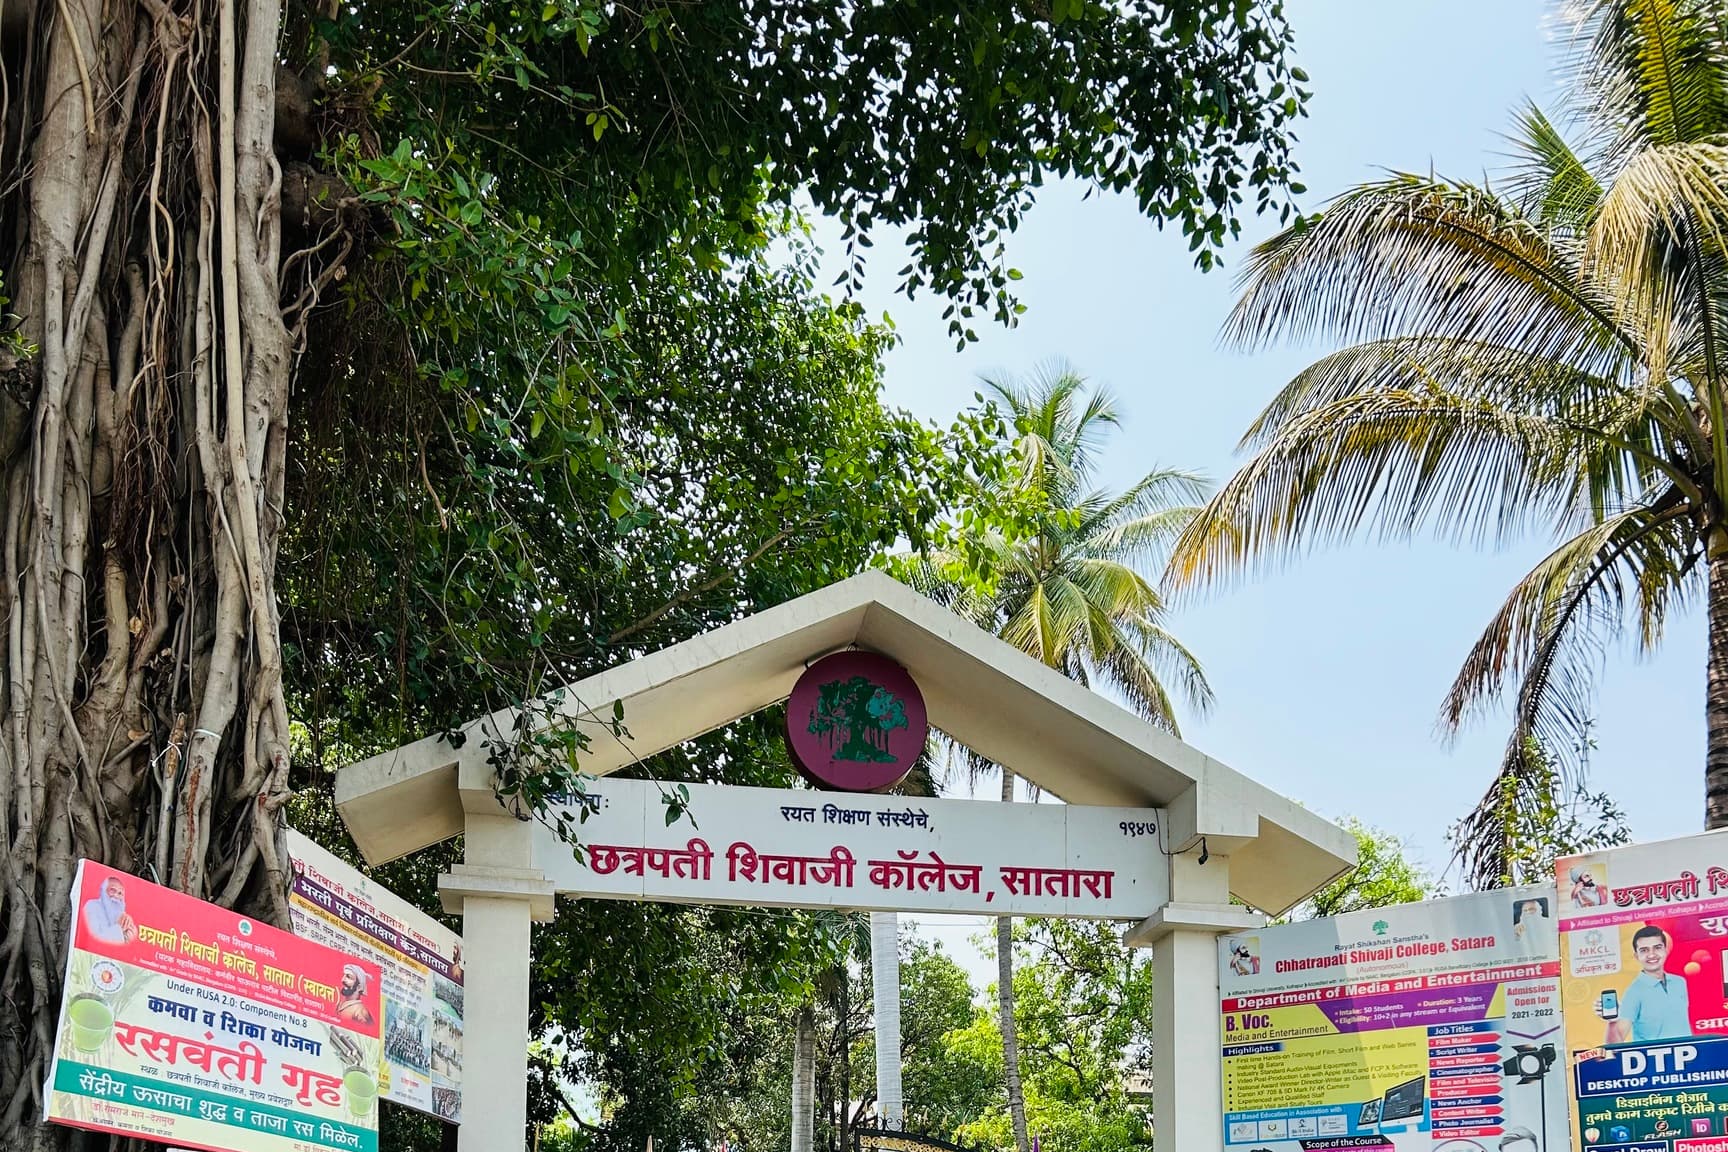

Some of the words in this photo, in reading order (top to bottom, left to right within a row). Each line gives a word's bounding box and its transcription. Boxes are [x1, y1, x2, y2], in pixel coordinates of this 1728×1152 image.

[780, 805, 817, 824] रयत
[822, 803, 871, 827] शिक्षण
[876, 807, 935, 833] संस्थेचे,
[1119, 821, 1157, 836] १९४७
[587, 838, 714, 881] छत्रपती
[726, 841, 858, 888] शिवाजी
[999, 866, 1115, 900] सातारा
[1611, 870, 1701, 907] छत्रपती
[301, 881, 332, 908] भरती
[356, 914, 397, 945] प्रशिक्षण
[1611, 913, 1633, 924] Shivaji
[1634, 909, 1667, 921] University,
[1668, 905, 1697, 916] Kolhapur
[1334, 943, 1355, 952] Rayat
[1392, 933, 1429, 944] Sanstha's
[138, 925, 178, 952] छत्रपती
[180, 931, 220, 965] शिवाजी
[263, 965, 295, 989] सातारा
[1275, 952, 1348, 973] Chhatrapati
[1350, 946, 1394, 964] Shivaji
[1396, 941, 1449, 958] College,
[1451, 935, 1495, 952] Satara
[1579, 946, 1610, 956] MKCL
[1357, 962, 1408, 974] (Autonomous)
[1237, 992, 1322, 1009] Department
[1326, 988, 1340, 999] of
[1345, 981, 1390, 996] Media
[1394, 977, 1422, 991] and
[1427, 965, 1542, 987] Entertainment
[1507, 984, 1557, 996] Admissions
[167, 979, 195, 995] Under
[196, 987, 221, 1003] RUSA
[240, 1000, 287, 1022] Component
[1423, 998, 1456, 1007] Duration:
[1464, 995, 1483, 1003] Years
[1514, 996, 1537, 1008] Open
[1537, 995, 1550, 1005] for
[1339, 1008, 1363, 1017] Intake:
[1373, 1003, 1404, 1012] Students
[1339, 1015, 1371, 1025] Eligibility:
[1373, 1013, 1390, 1021] 10+2
[1391, 1011, 1399, 1019] in
[1399, 1011, 1413, 1019] any
[1413, 1008, 1438, 1016] stream
[1448, 1004, 1486, 1013] Equivalent
[147, 995, 199, 1024] कमवा
[203, 1010, 217, 1028] व
[220, 1011, 268, 1041] शिका
[271, 1027, 323, 1057] योजना
[1225, 1015, 1239, 1032] B.
[1242, 1014, 1274, 1029] Voc.
[1225, 1033, 1250, 1043] Media
[1251, 1029, 1267, 1040] and
[1269, 1024, 1328, 1038] Entertainment
[1434, 1026, 1451, 1036] Job
[1451, 1025, 1474, 1034] Titles
[1436, 1038, 1451, 1046] Film
[1451, 1037, 1472, 1045] Maker
[1228, 1045, 1274, 1055] Highlights
[1436, 1048, 1456, 1057] Script
[1457, 1046, 1478, 1054] Writer
[1579, 1050, 1598, 1061] NEW
[114, 1020, 268, 1086] रसवंती
[280, 1062, 344, 1107] गृह
[1436, 1059, 1455, 1067] News
[1456, 1056, 1486, 1066] Reporter
[1621, 1045, 1698, 1076] DTP
[1436, 1066, 1495, 1077] Cinematographer
[166, 1069, 192, 1083] छत्रपती
[194, 1074, 220, 1090] शिवाजी
[1437, 1079, 1452, 1087] Film
[1452, 1077, 1466, 1085] and
[1587, 1077, 1649, 1091] DESKTOP
[1437, 1089, 1468, 1097] Producer
[1615, 1093, 1673, 1108] डिझाइनिंग
[1675, 1091, 1708, 1104] क्षेत्रात
[79, 1068, 126, 1098] सेंद्रीय
[132, 1085, 193, 1111] ऊसाचा
[199, 1099, 228, 1122] शुद्ध
[233, 1106, 247, 1123] व
[250, 1111, 288, 1133] ताजा
[293, 1120, 314, 1137] रस
[320, 1124, 364, 1149] मिळेल.
[1437, 1099, 1456, 1107] News
[1457, 1098, 1482, 1106] Anchor
[1260, 1110, 1288, 1119] Education
[1295, 1107, 1330, 1116] Association
[1438, 1108, 1465, 1117] Content
[1466, 1107, 1487, 1115] Writer
[1585, 1109, 1612, 1126] तुमचे
[1615, 1109, 1641, 1120] काम
[1643, 1106, 1679, 1120] उत्कृष्ट
[1681, 1101, 1715, 1115] रितीने
[1439, 1120, 1459, 1128] Photo
[1461, 1117, 1494, 1126] Journalist
[1439, 1130, 1459, 1138] Video
[1460, 1129, 1481, 1137] Editor
[1644, 1128, 1682, 1140] FLASH
[1306, 1140, 1330, 1150] Scope
[1331, 1138, 1339, 1147] of
[1343, 1138, 1354, 1146] the
[1355, 1137, 1383, 1145] Course
